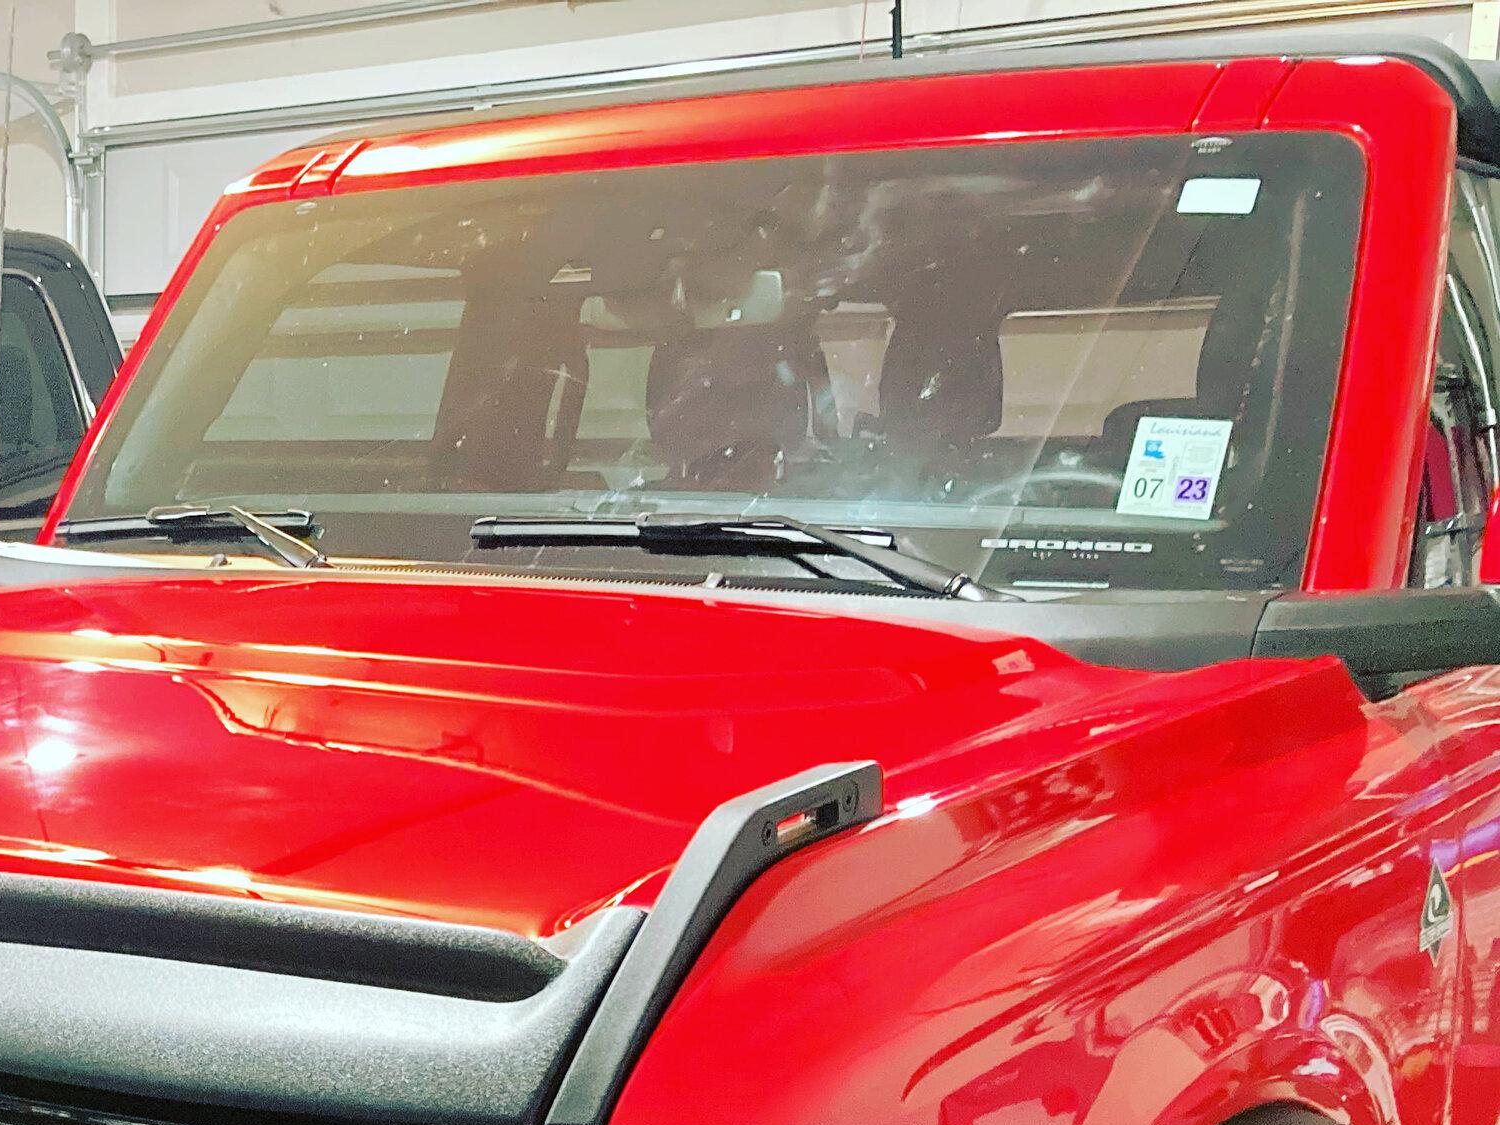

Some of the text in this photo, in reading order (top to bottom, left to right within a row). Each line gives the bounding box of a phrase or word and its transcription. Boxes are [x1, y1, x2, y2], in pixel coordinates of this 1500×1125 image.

[1150, 421, 1224, 437] Louisiana
[1133, 477, 1208, 500] 07 23
